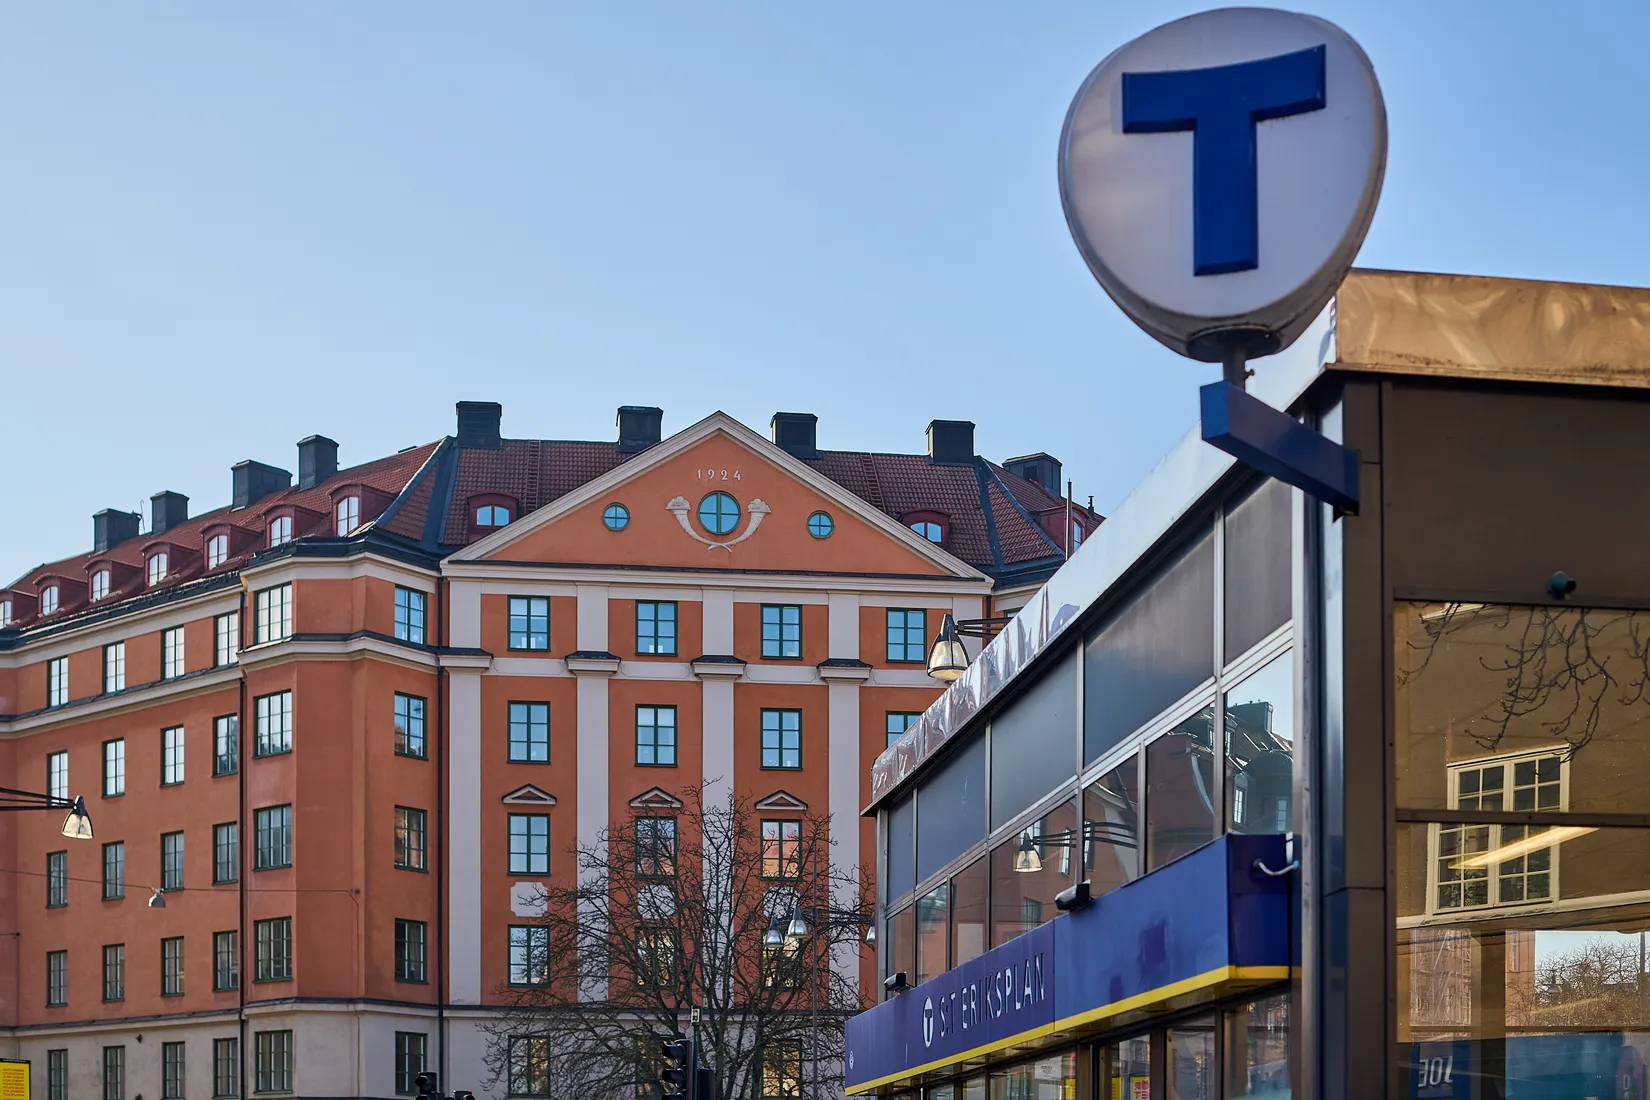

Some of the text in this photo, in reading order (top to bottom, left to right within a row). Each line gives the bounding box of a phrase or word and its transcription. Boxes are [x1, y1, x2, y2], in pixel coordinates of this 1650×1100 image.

[1122, 43, 1327, 277] T
[697, 468, 741, 480] 1924
[961, 953, 1045, 1029] ERIKSPLAN
